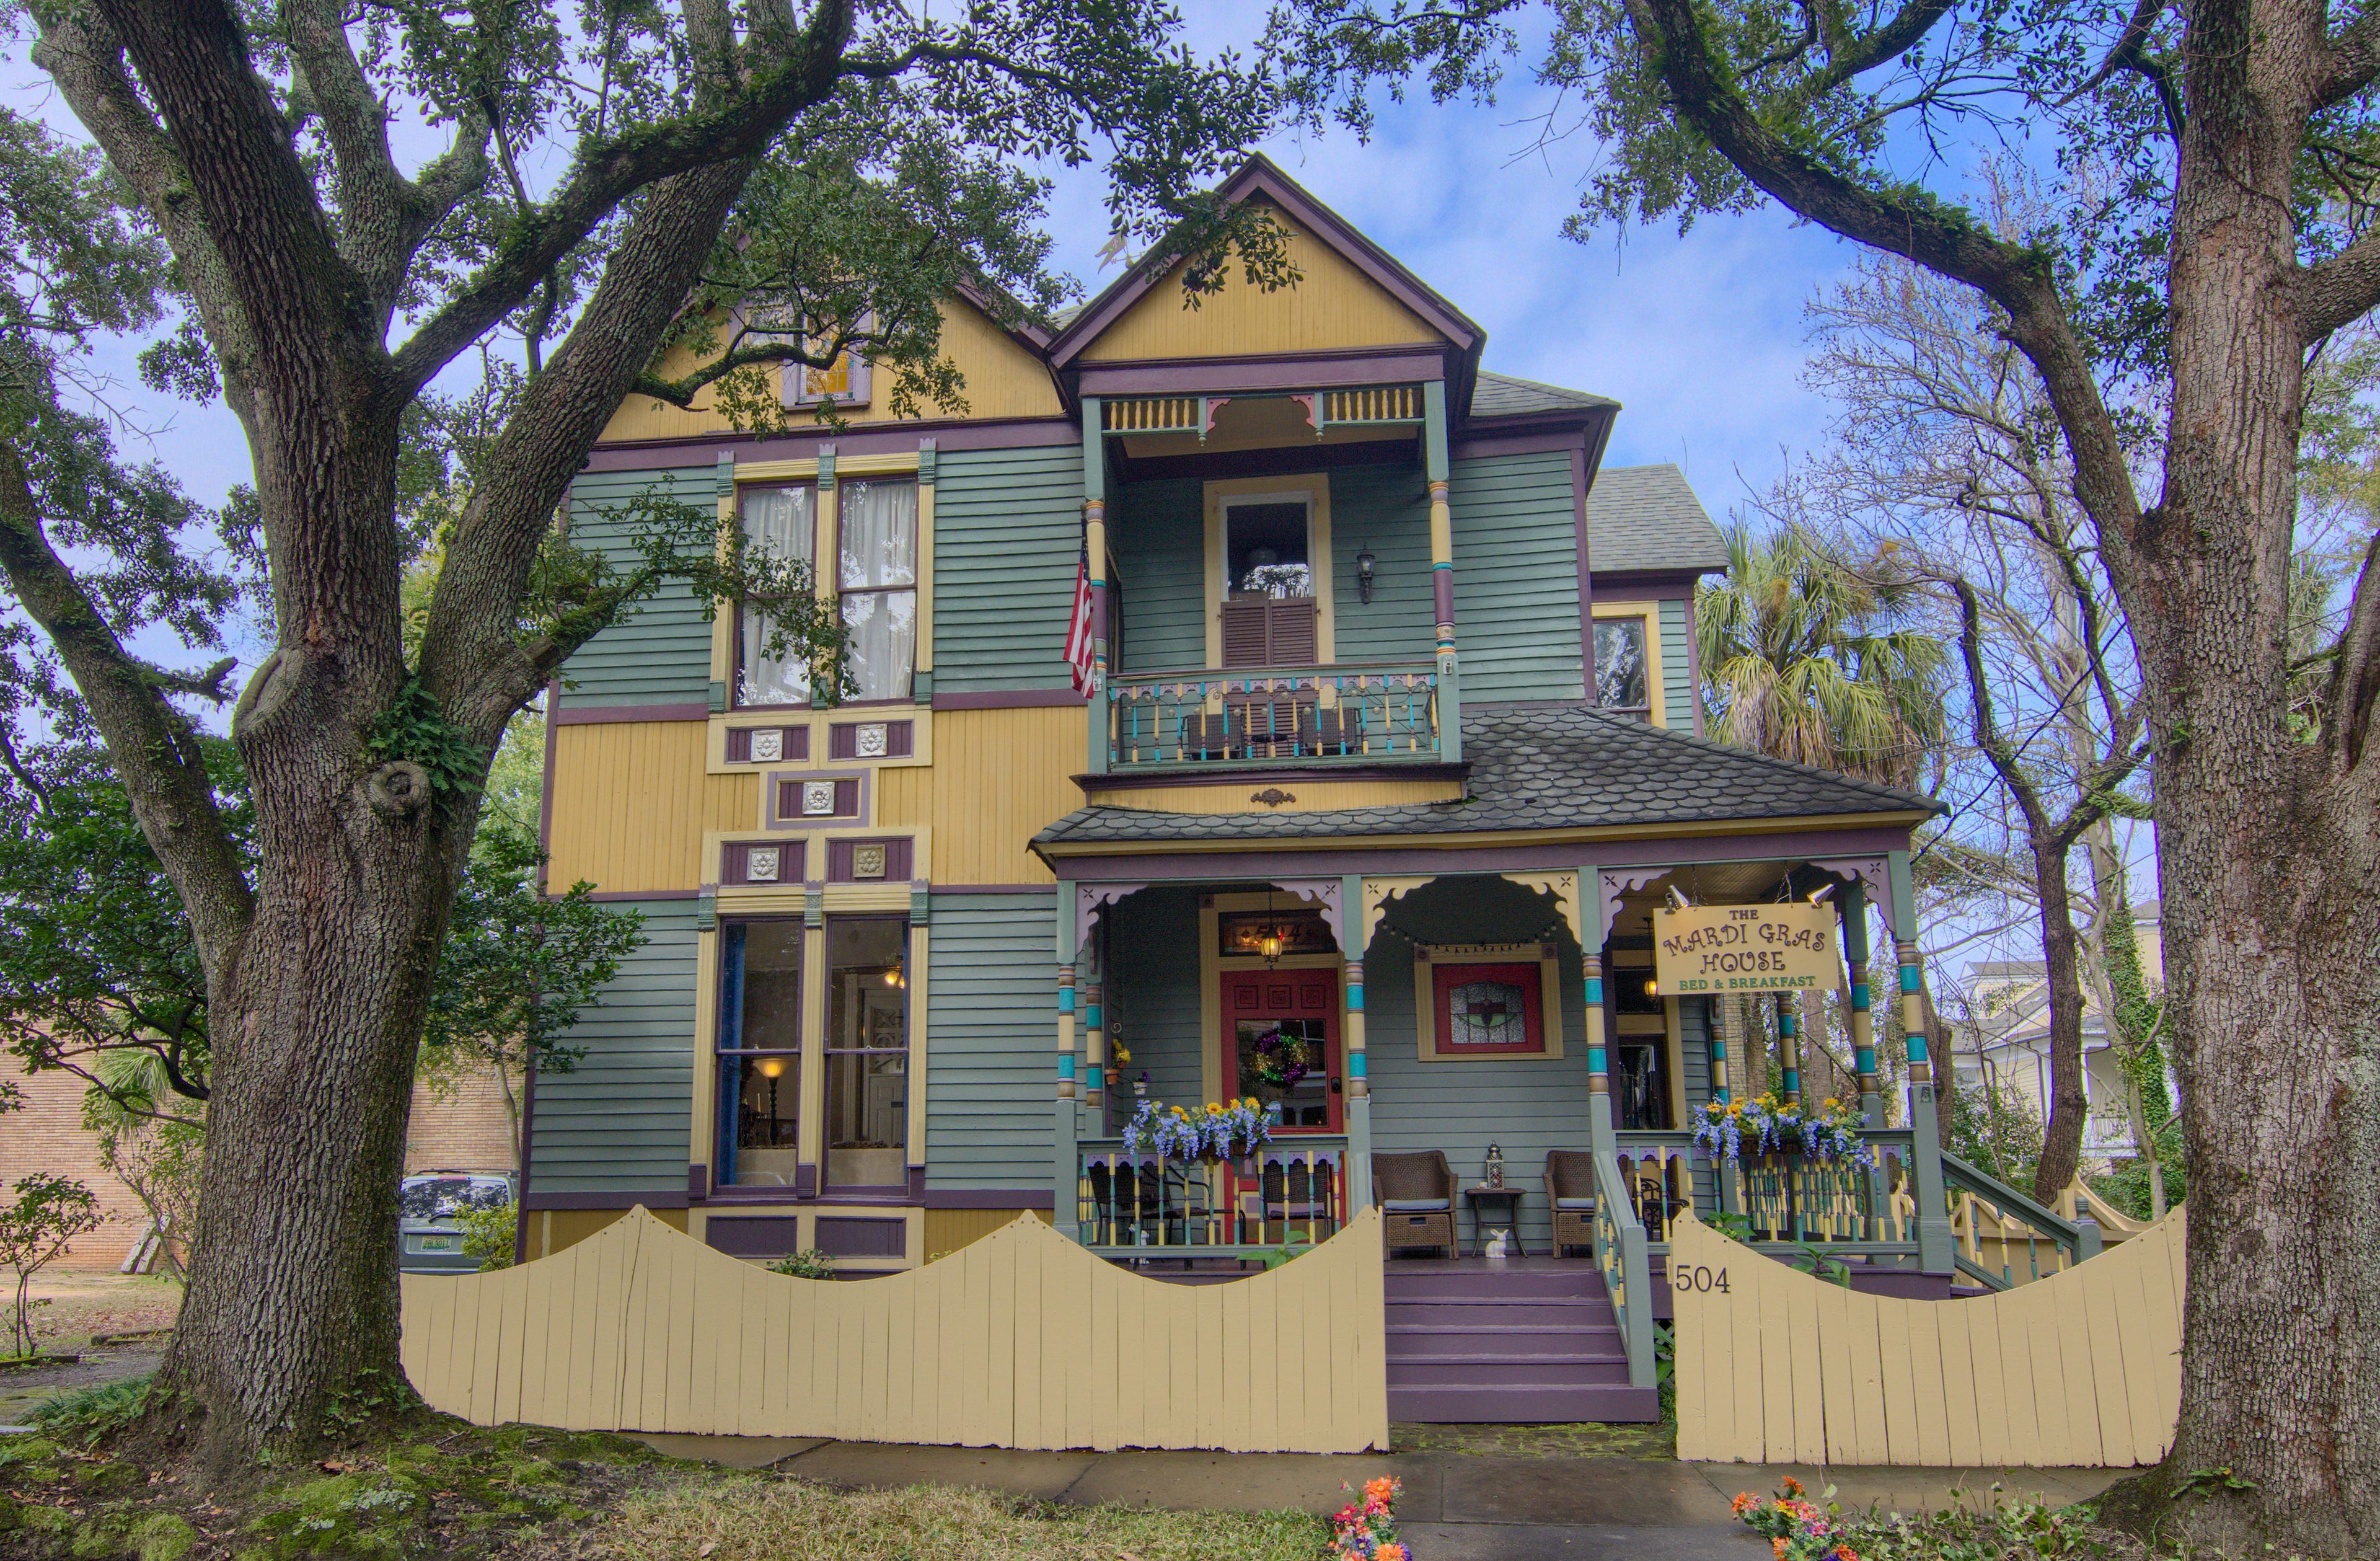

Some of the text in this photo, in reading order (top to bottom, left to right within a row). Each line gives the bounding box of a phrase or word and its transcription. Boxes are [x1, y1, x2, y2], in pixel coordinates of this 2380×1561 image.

[1729, 909, 1759, 921] THE
[1663, 923, 1825, 957] MARDI GRAS
[1699, 951, 1786, 974] HOUSE
[1679, 976, 1815, 991] BED & BREAKFAST
[1676, 1265, 1730, 1293] 504
